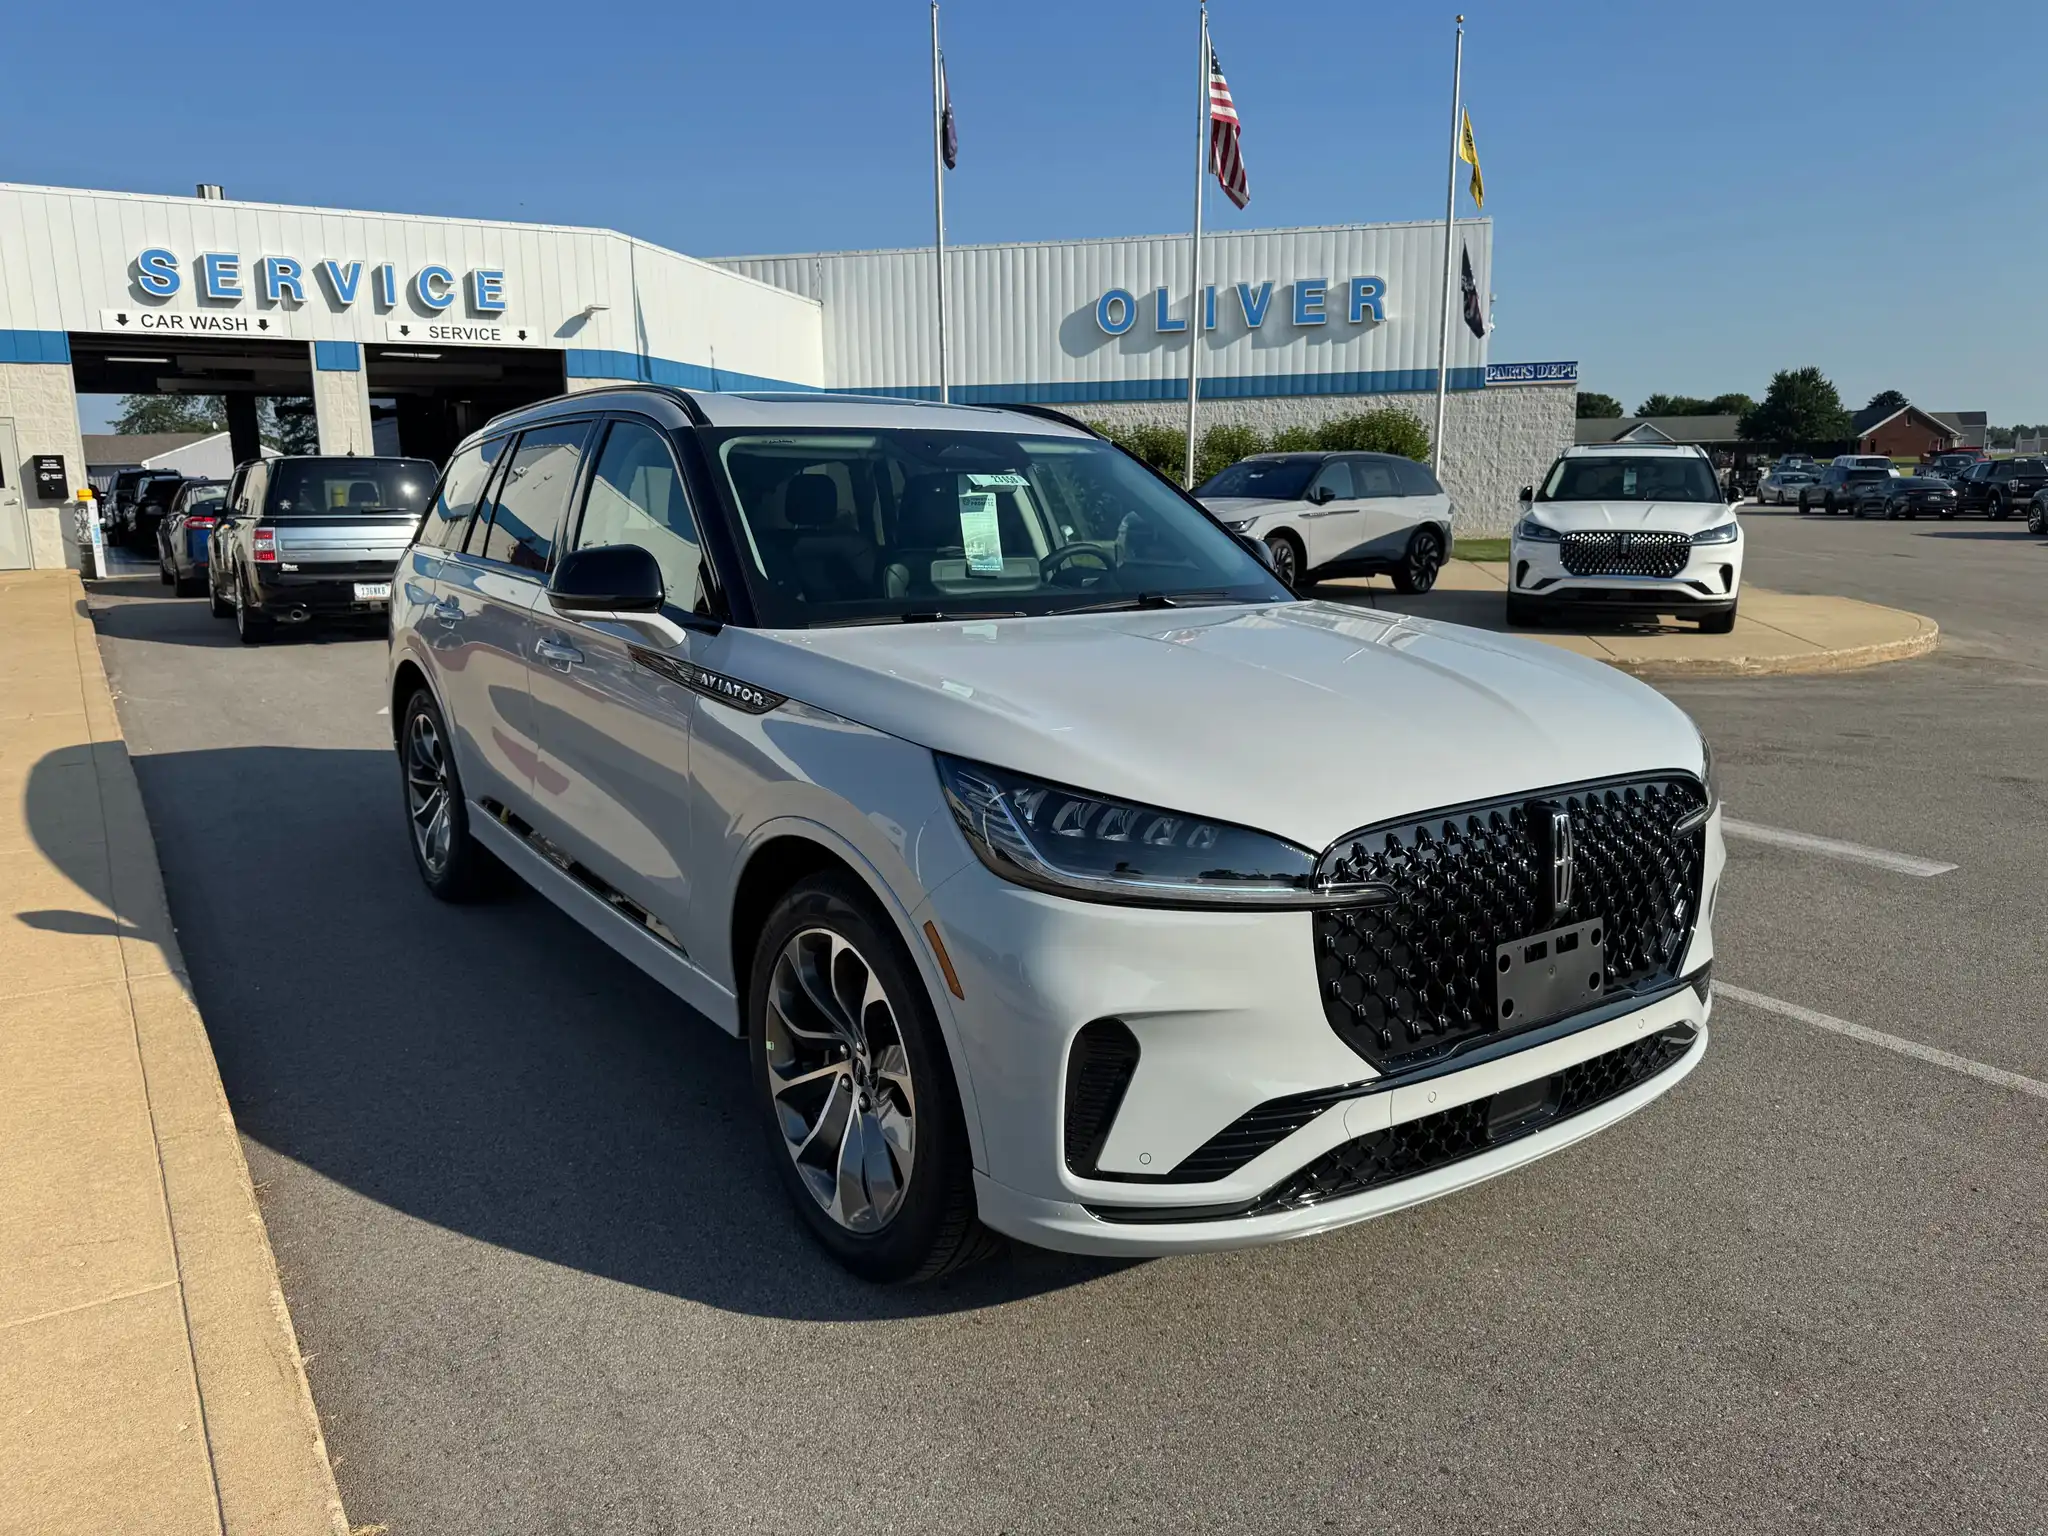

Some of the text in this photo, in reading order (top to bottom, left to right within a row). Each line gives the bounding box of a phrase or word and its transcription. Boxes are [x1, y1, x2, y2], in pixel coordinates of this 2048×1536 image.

[138, 248, 507, 311] SERVICE
[1096, 275, 1387, 335] OLIVER
[140, 314, 248, 332] CAR WASH
[429, 326, 501, 341] SERVICE
[1486, 363, 1577, 380] PARTS DEPT
[700, 673, 763, 706] AVIATOR
